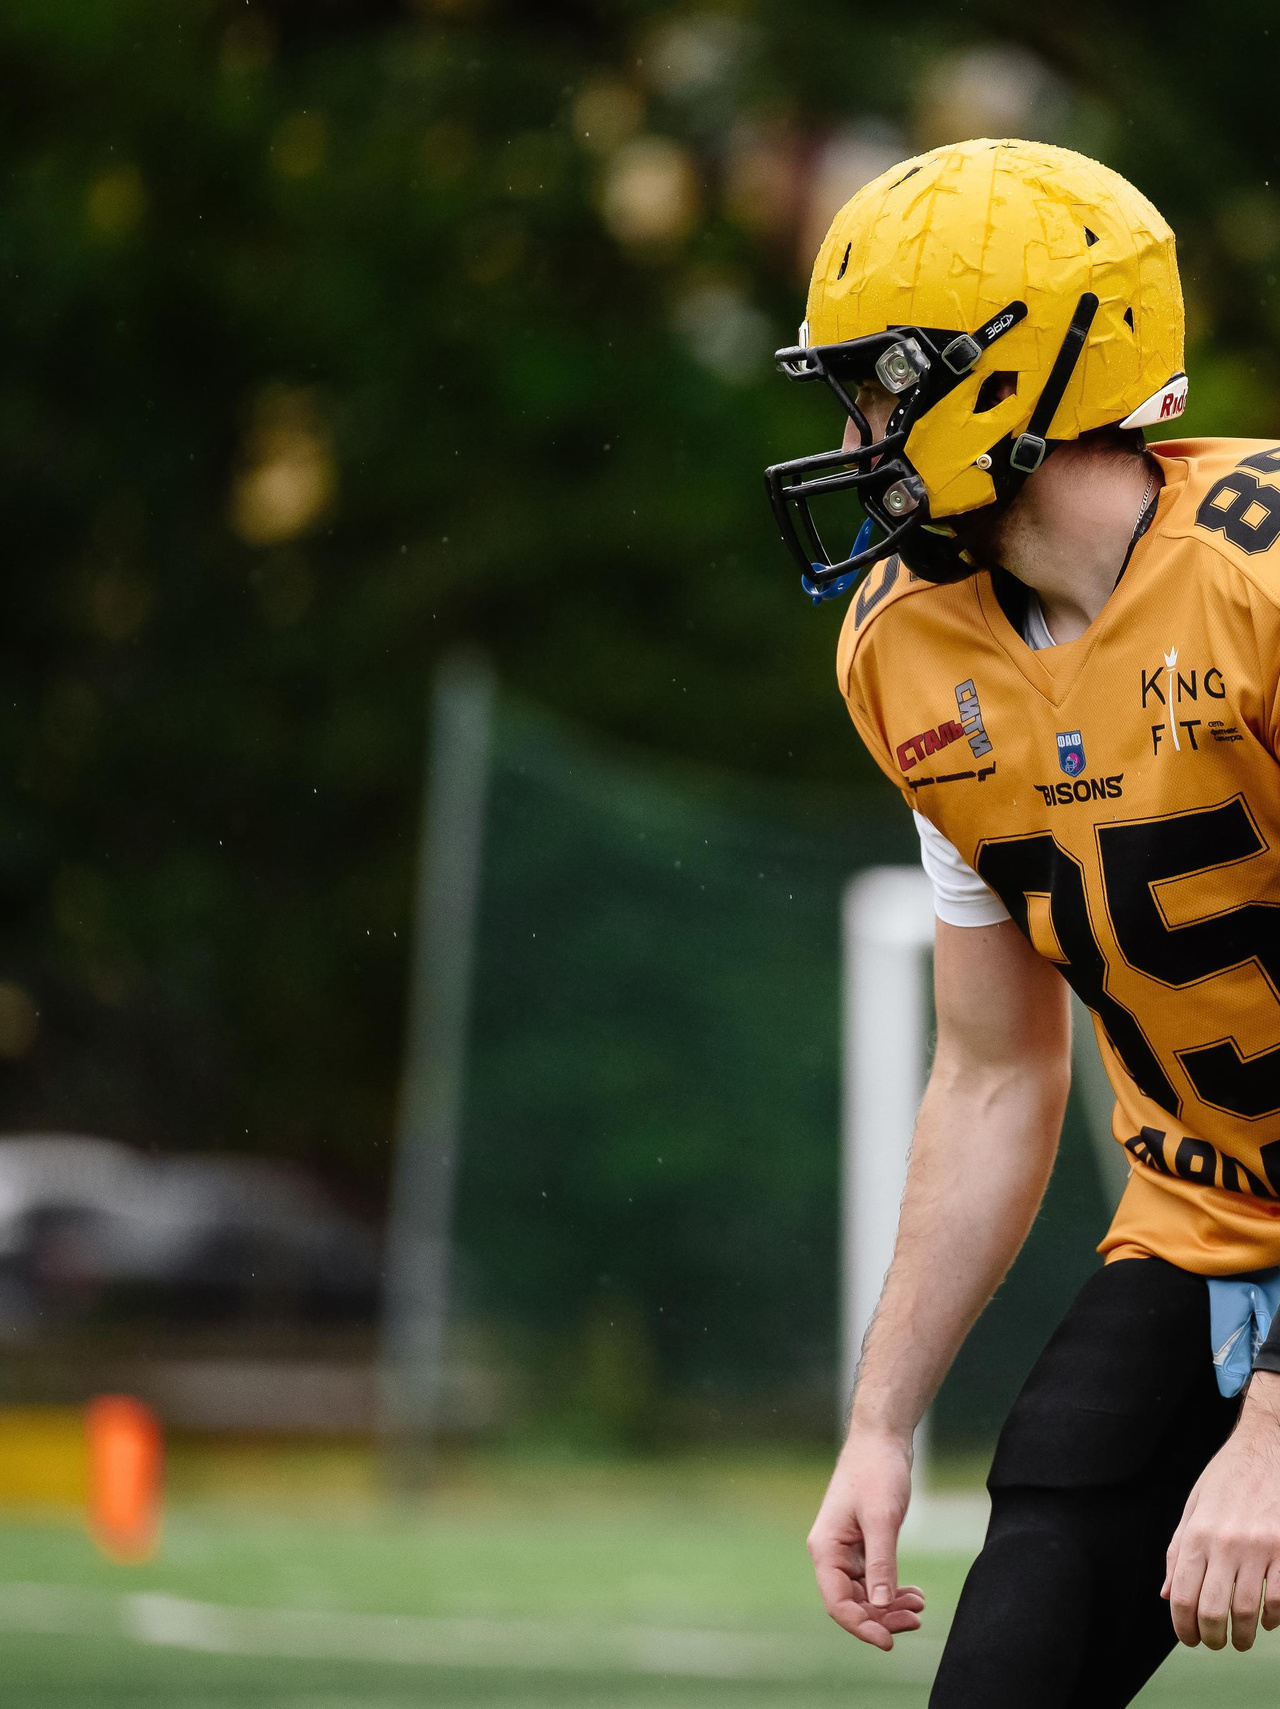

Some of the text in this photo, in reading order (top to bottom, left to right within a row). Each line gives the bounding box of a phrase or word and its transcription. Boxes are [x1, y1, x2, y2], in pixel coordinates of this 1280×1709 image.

[985, 314, 1014, 340] 360
[955, 678, 993, 759] СИТИ
[896, 719, 965, 772] СТАЛЬ
[1033, 773, 1124, 807] BISONS
